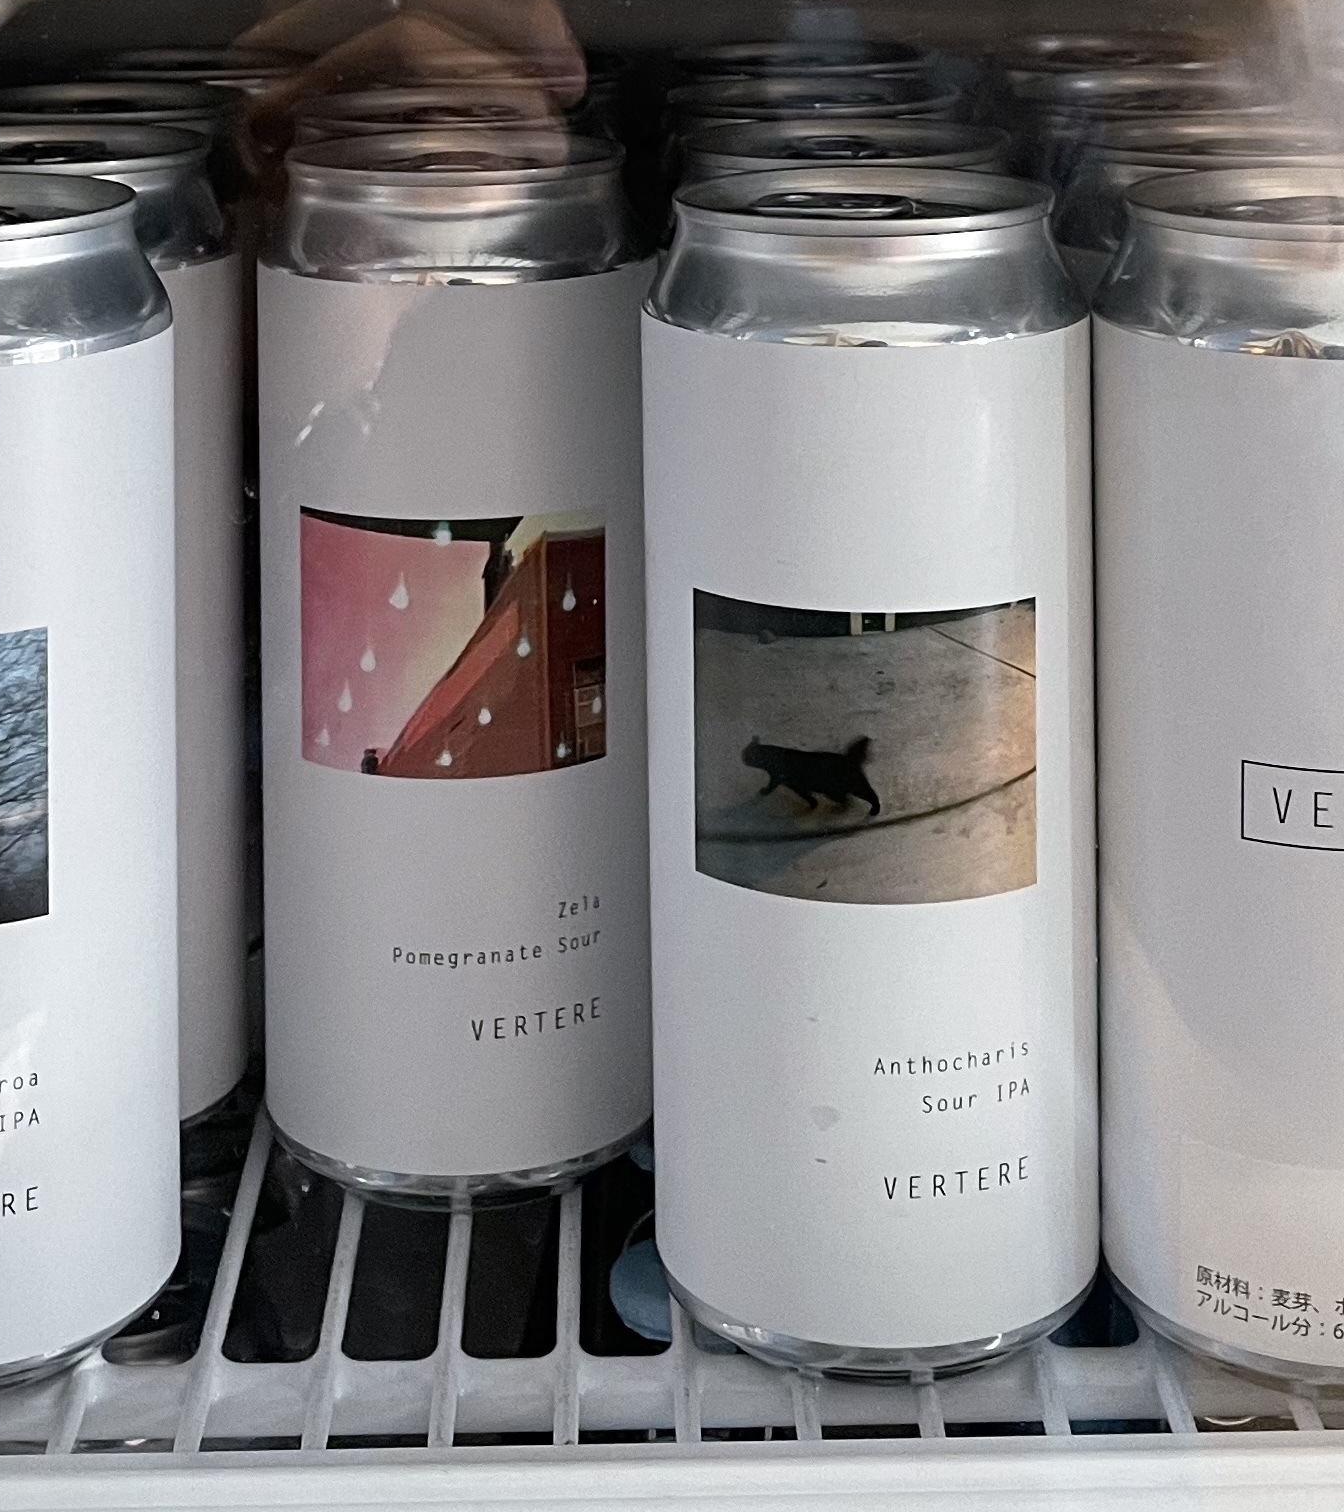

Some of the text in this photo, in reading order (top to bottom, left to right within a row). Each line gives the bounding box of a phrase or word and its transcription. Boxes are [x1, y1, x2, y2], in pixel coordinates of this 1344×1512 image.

[392, 929, 601, 969] Pomegranate Sour
[471, 996, 601, 1042] VERTERE
[873, 1041, 1030, 1076] Anthocharis
[921, 1077, 1030, 1114] Sour IPA
[884, 1155, 1029, 1200] VERTERE
